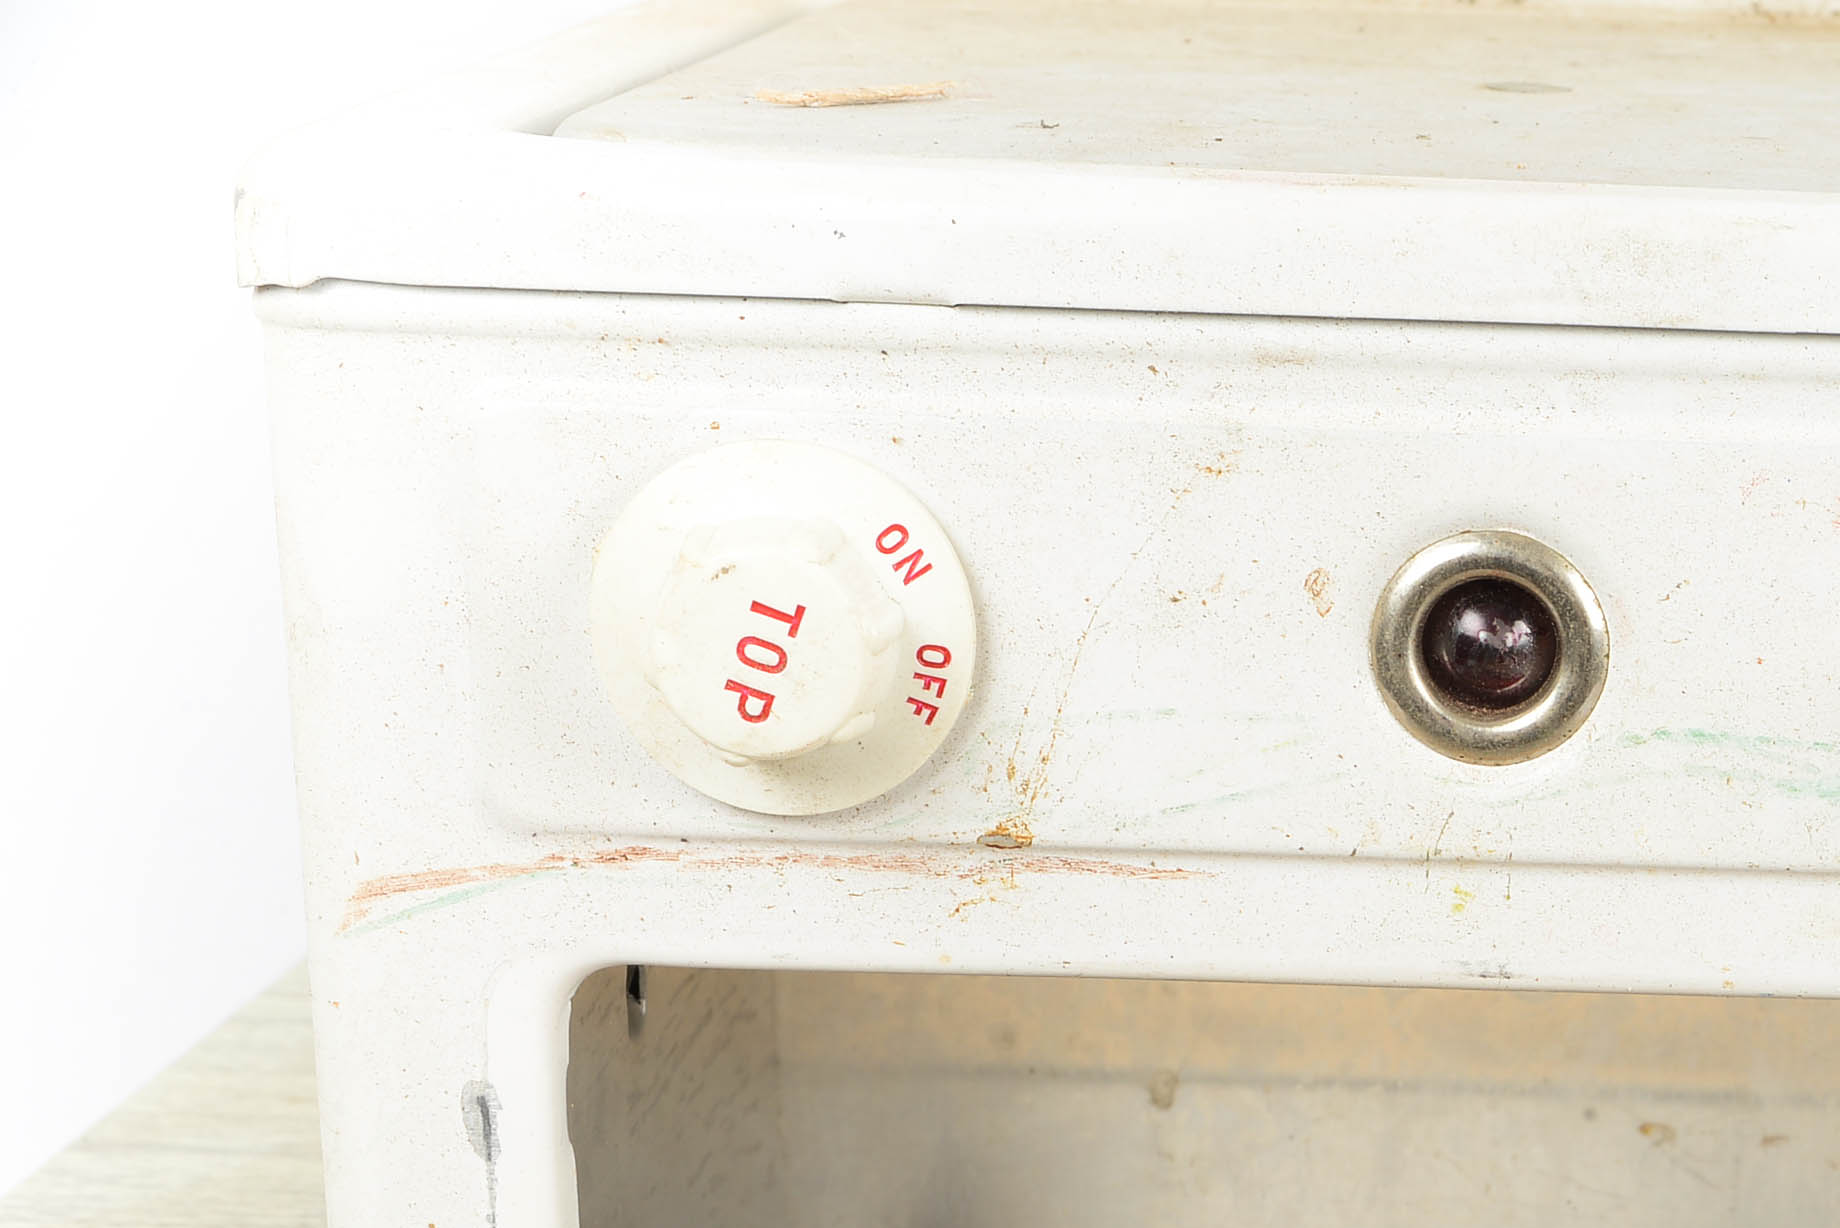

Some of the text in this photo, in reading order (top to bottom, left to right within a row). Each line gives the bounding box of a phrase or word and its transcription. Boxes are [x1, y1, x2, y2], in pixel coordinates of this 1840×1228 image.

[875, 523, 934, 586] ON
[723, 600, 807, 724] TOP
[906, 644, 953, 726] OFF
